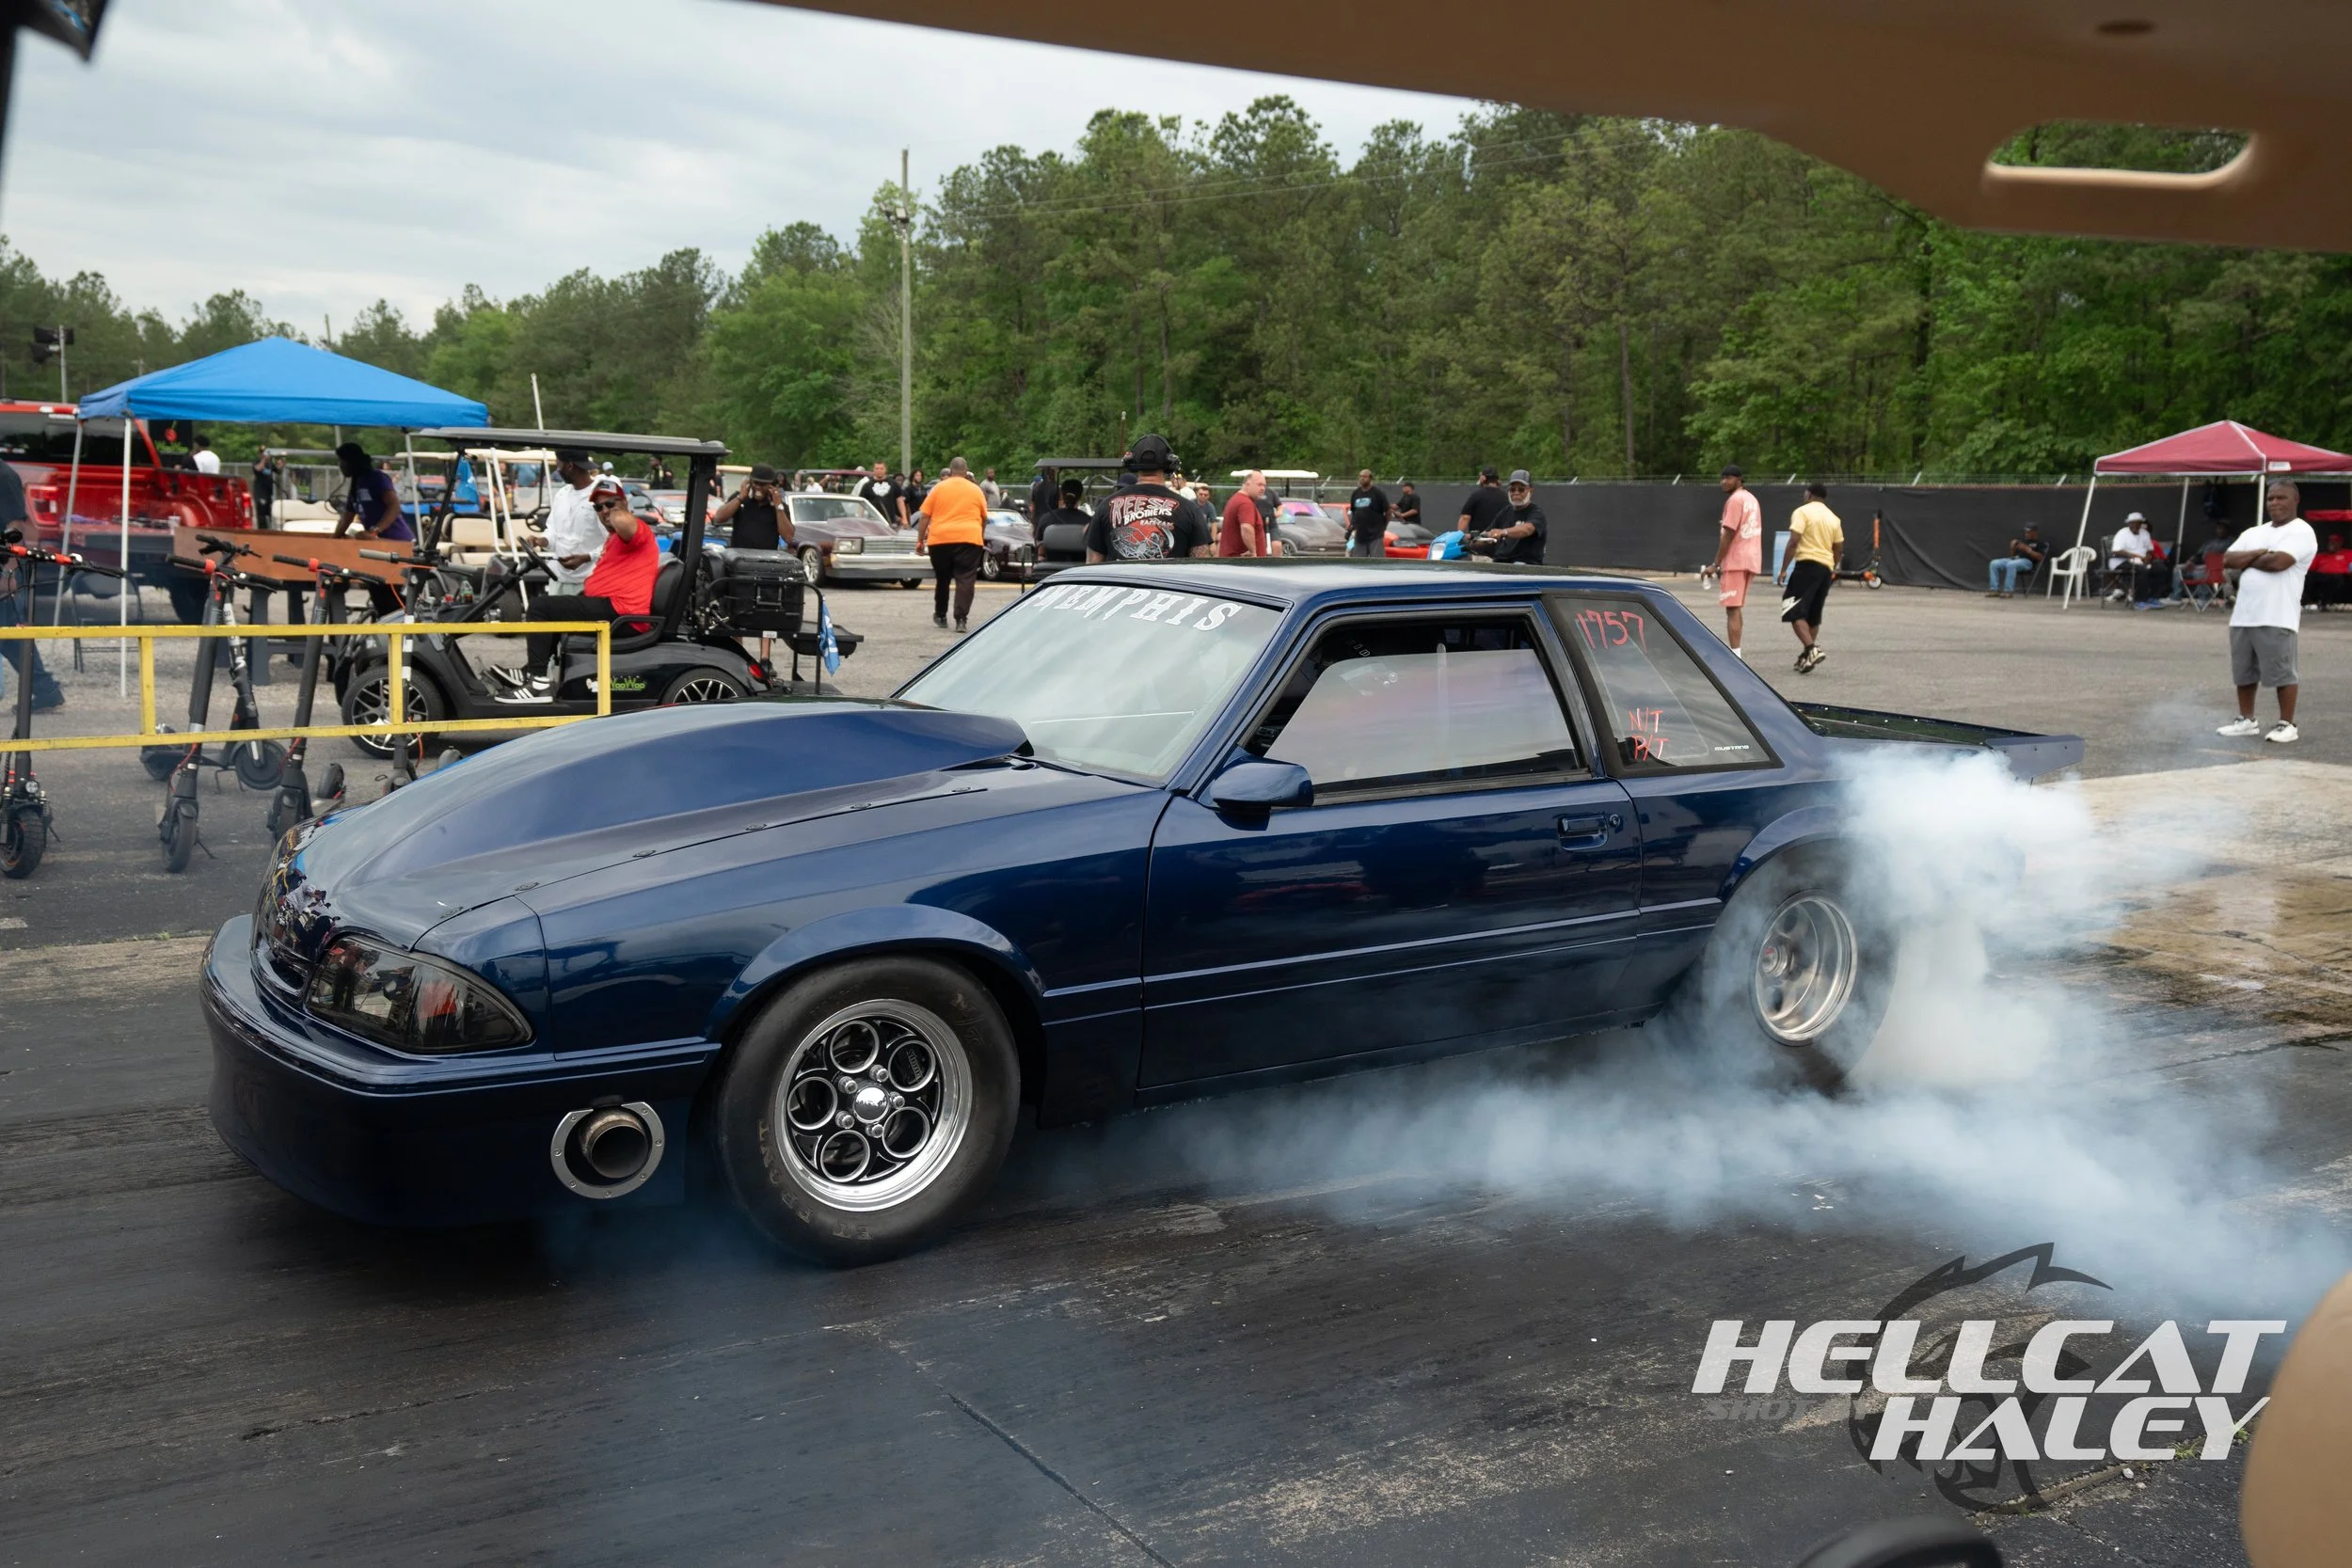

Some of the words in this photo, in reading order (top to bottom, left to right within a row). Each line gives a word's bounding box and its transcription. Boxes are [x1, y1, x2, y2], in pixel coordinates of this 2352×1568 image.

[1110, 495, 1178, 528] REESE
[1011, 584, 1242, 631] MEMPHIS
[1576, 610, 1647, 656] 1757
